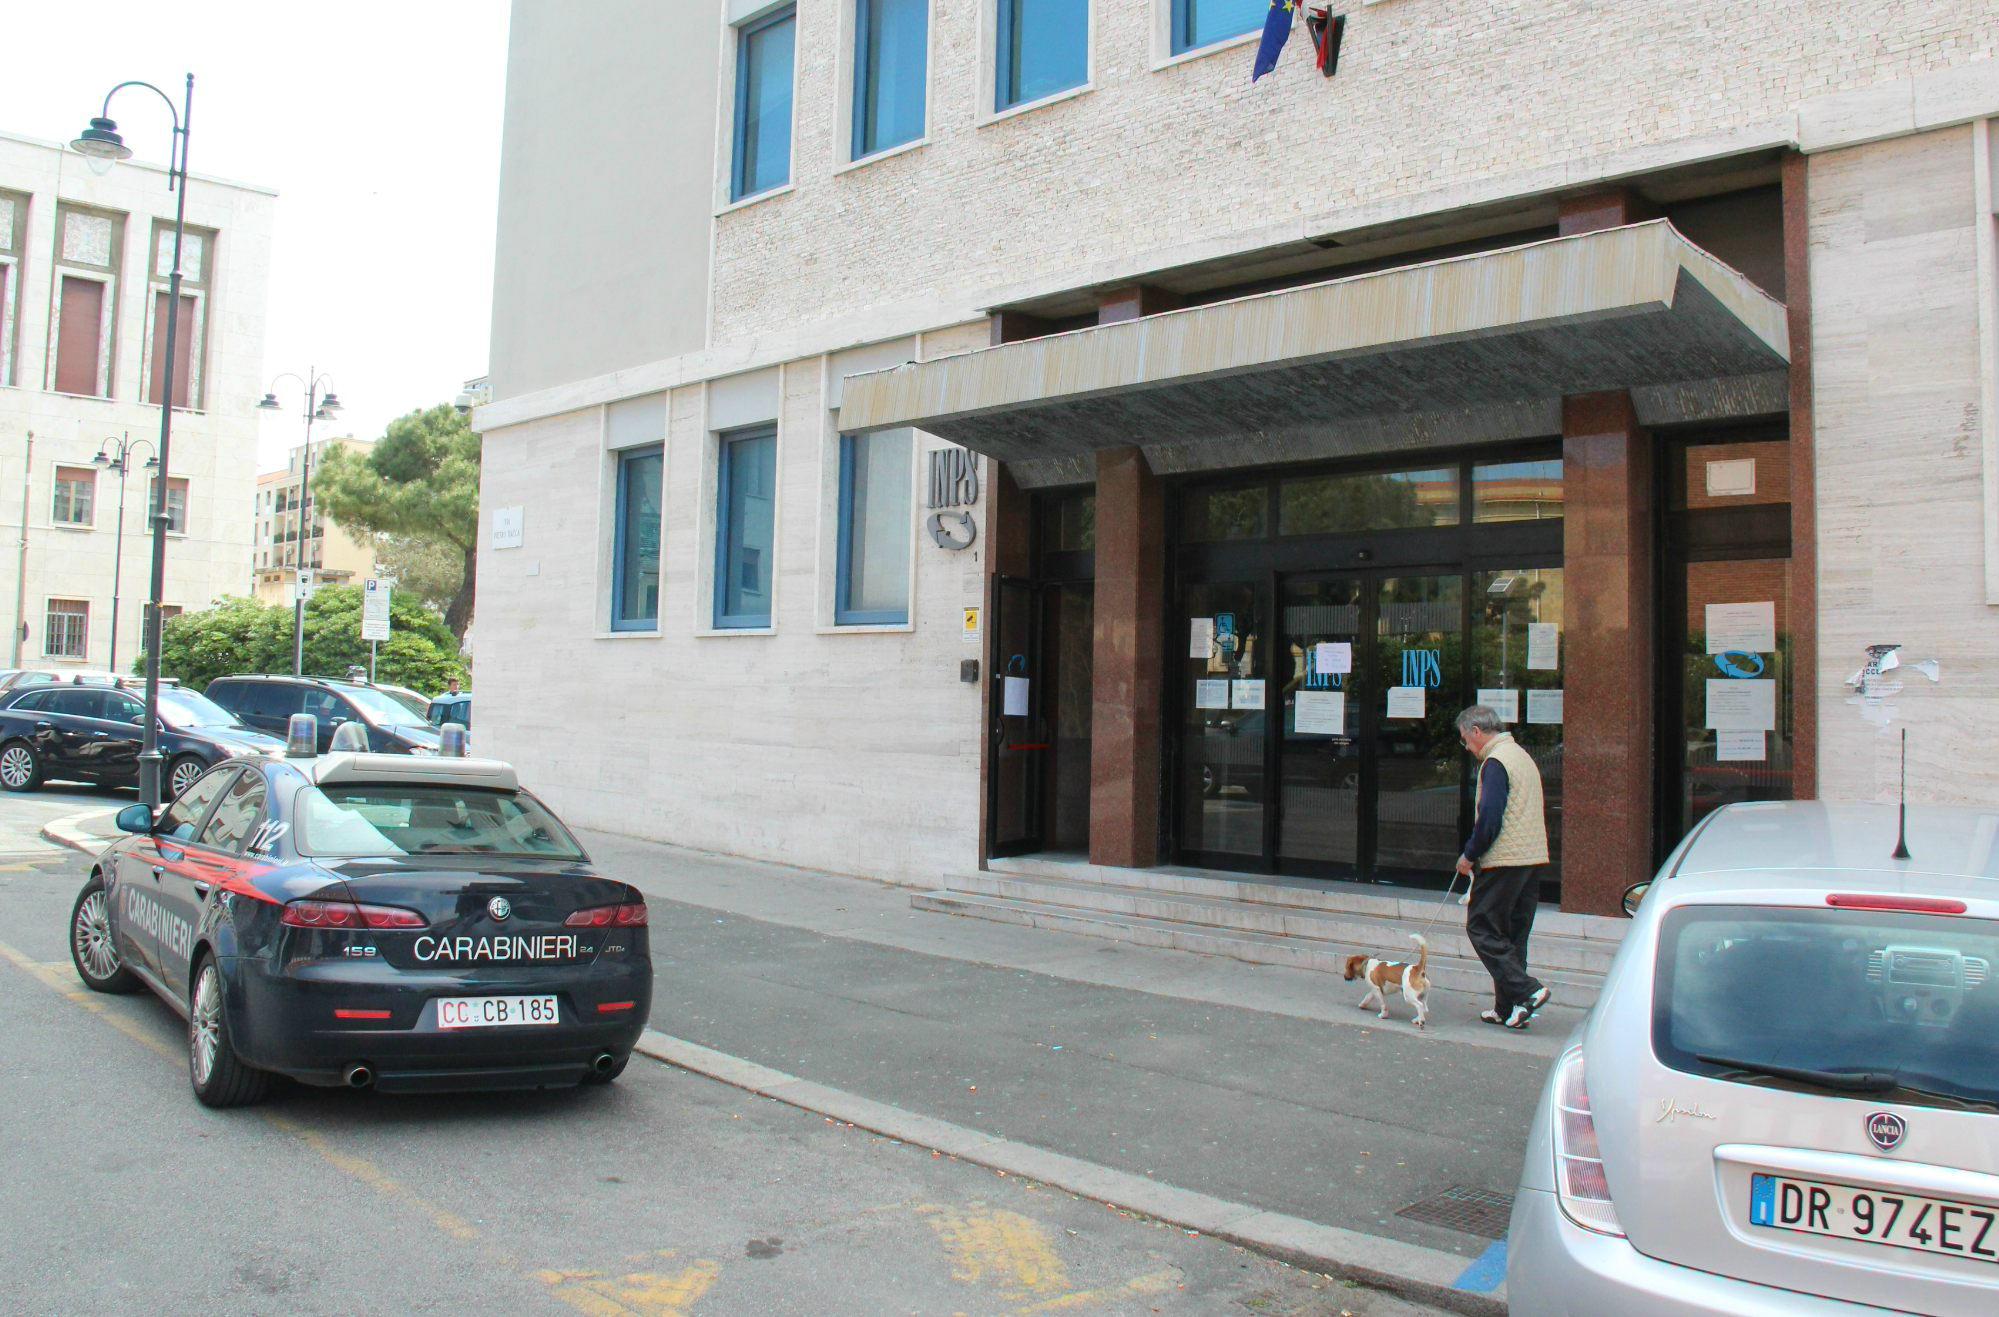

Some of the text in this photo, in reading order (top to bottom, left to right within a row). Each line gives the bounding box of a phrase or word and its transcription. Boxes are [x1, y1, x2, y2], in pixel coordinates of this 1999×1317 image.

[928, 447, 978, 507] INPS
[1401, 649, 1441, 688] INPS
[249, 818, 290, 851] 112
[128, 887, 192, 962] CARABINIERI
[342, 946, 376, 957] 159
[413, 934, 577, 961] CARABINIERI
[442, 999, 554, 1024] CC CB 185
[1872, 1123, 1900, 1136] LANCIA
[1780, 1182, 1831, 1230] DR
[1851, 1193, 1996, 1257] 974EZ
